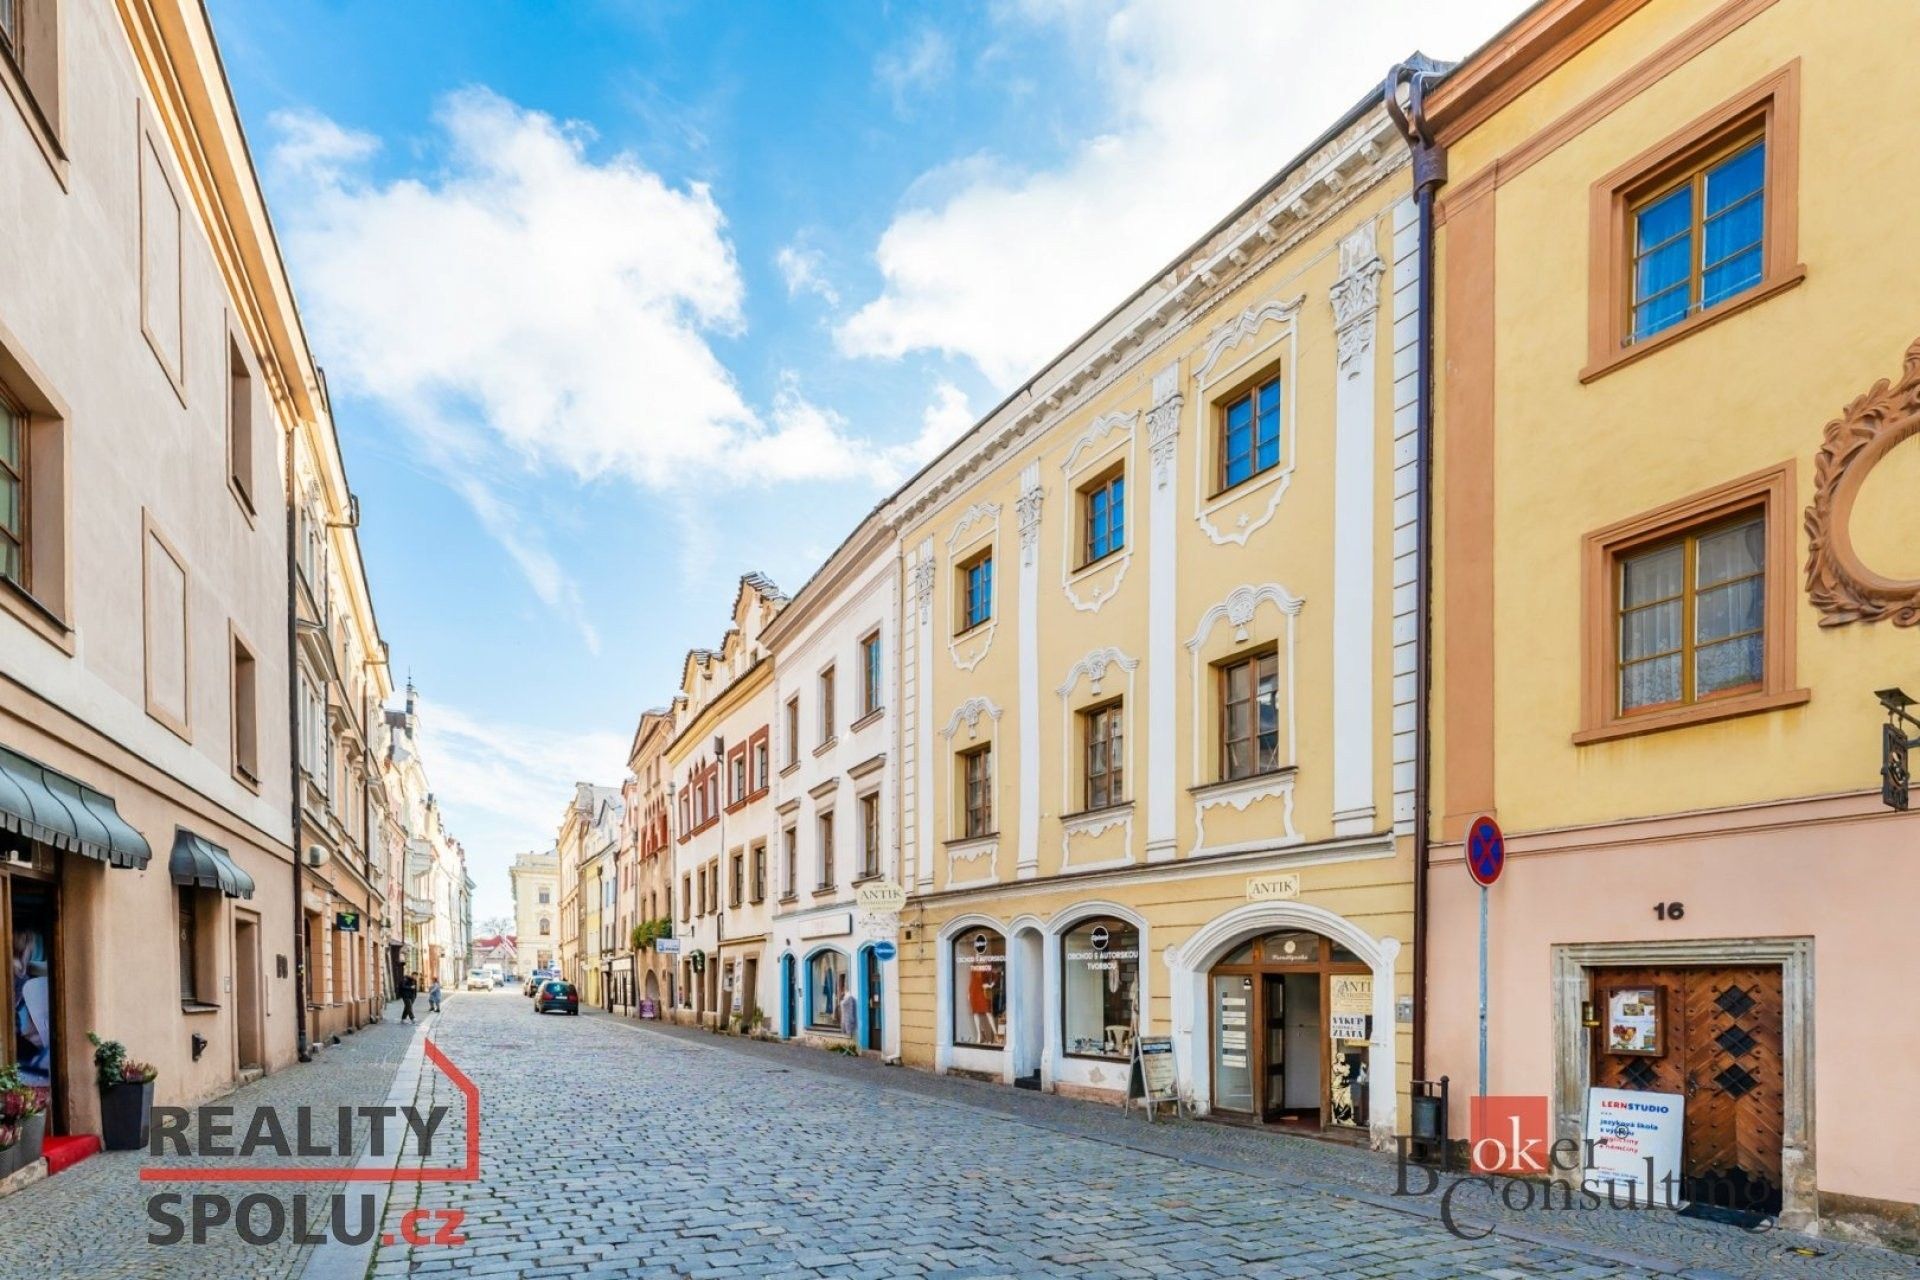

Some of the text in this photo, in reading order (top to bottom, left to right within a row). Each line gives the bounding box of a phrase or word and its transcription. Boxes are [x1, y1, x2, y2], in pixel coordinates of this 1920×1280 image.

[862, 889, 902, 900] ANTIK
[1253, 881, 1293, 895] ANTIK
[1653, 901, 1685, 921] 16
[1342, 980, 1371, 993] ANTI
[1601, 1101, 1669, 1114] LERNSTUDIO
